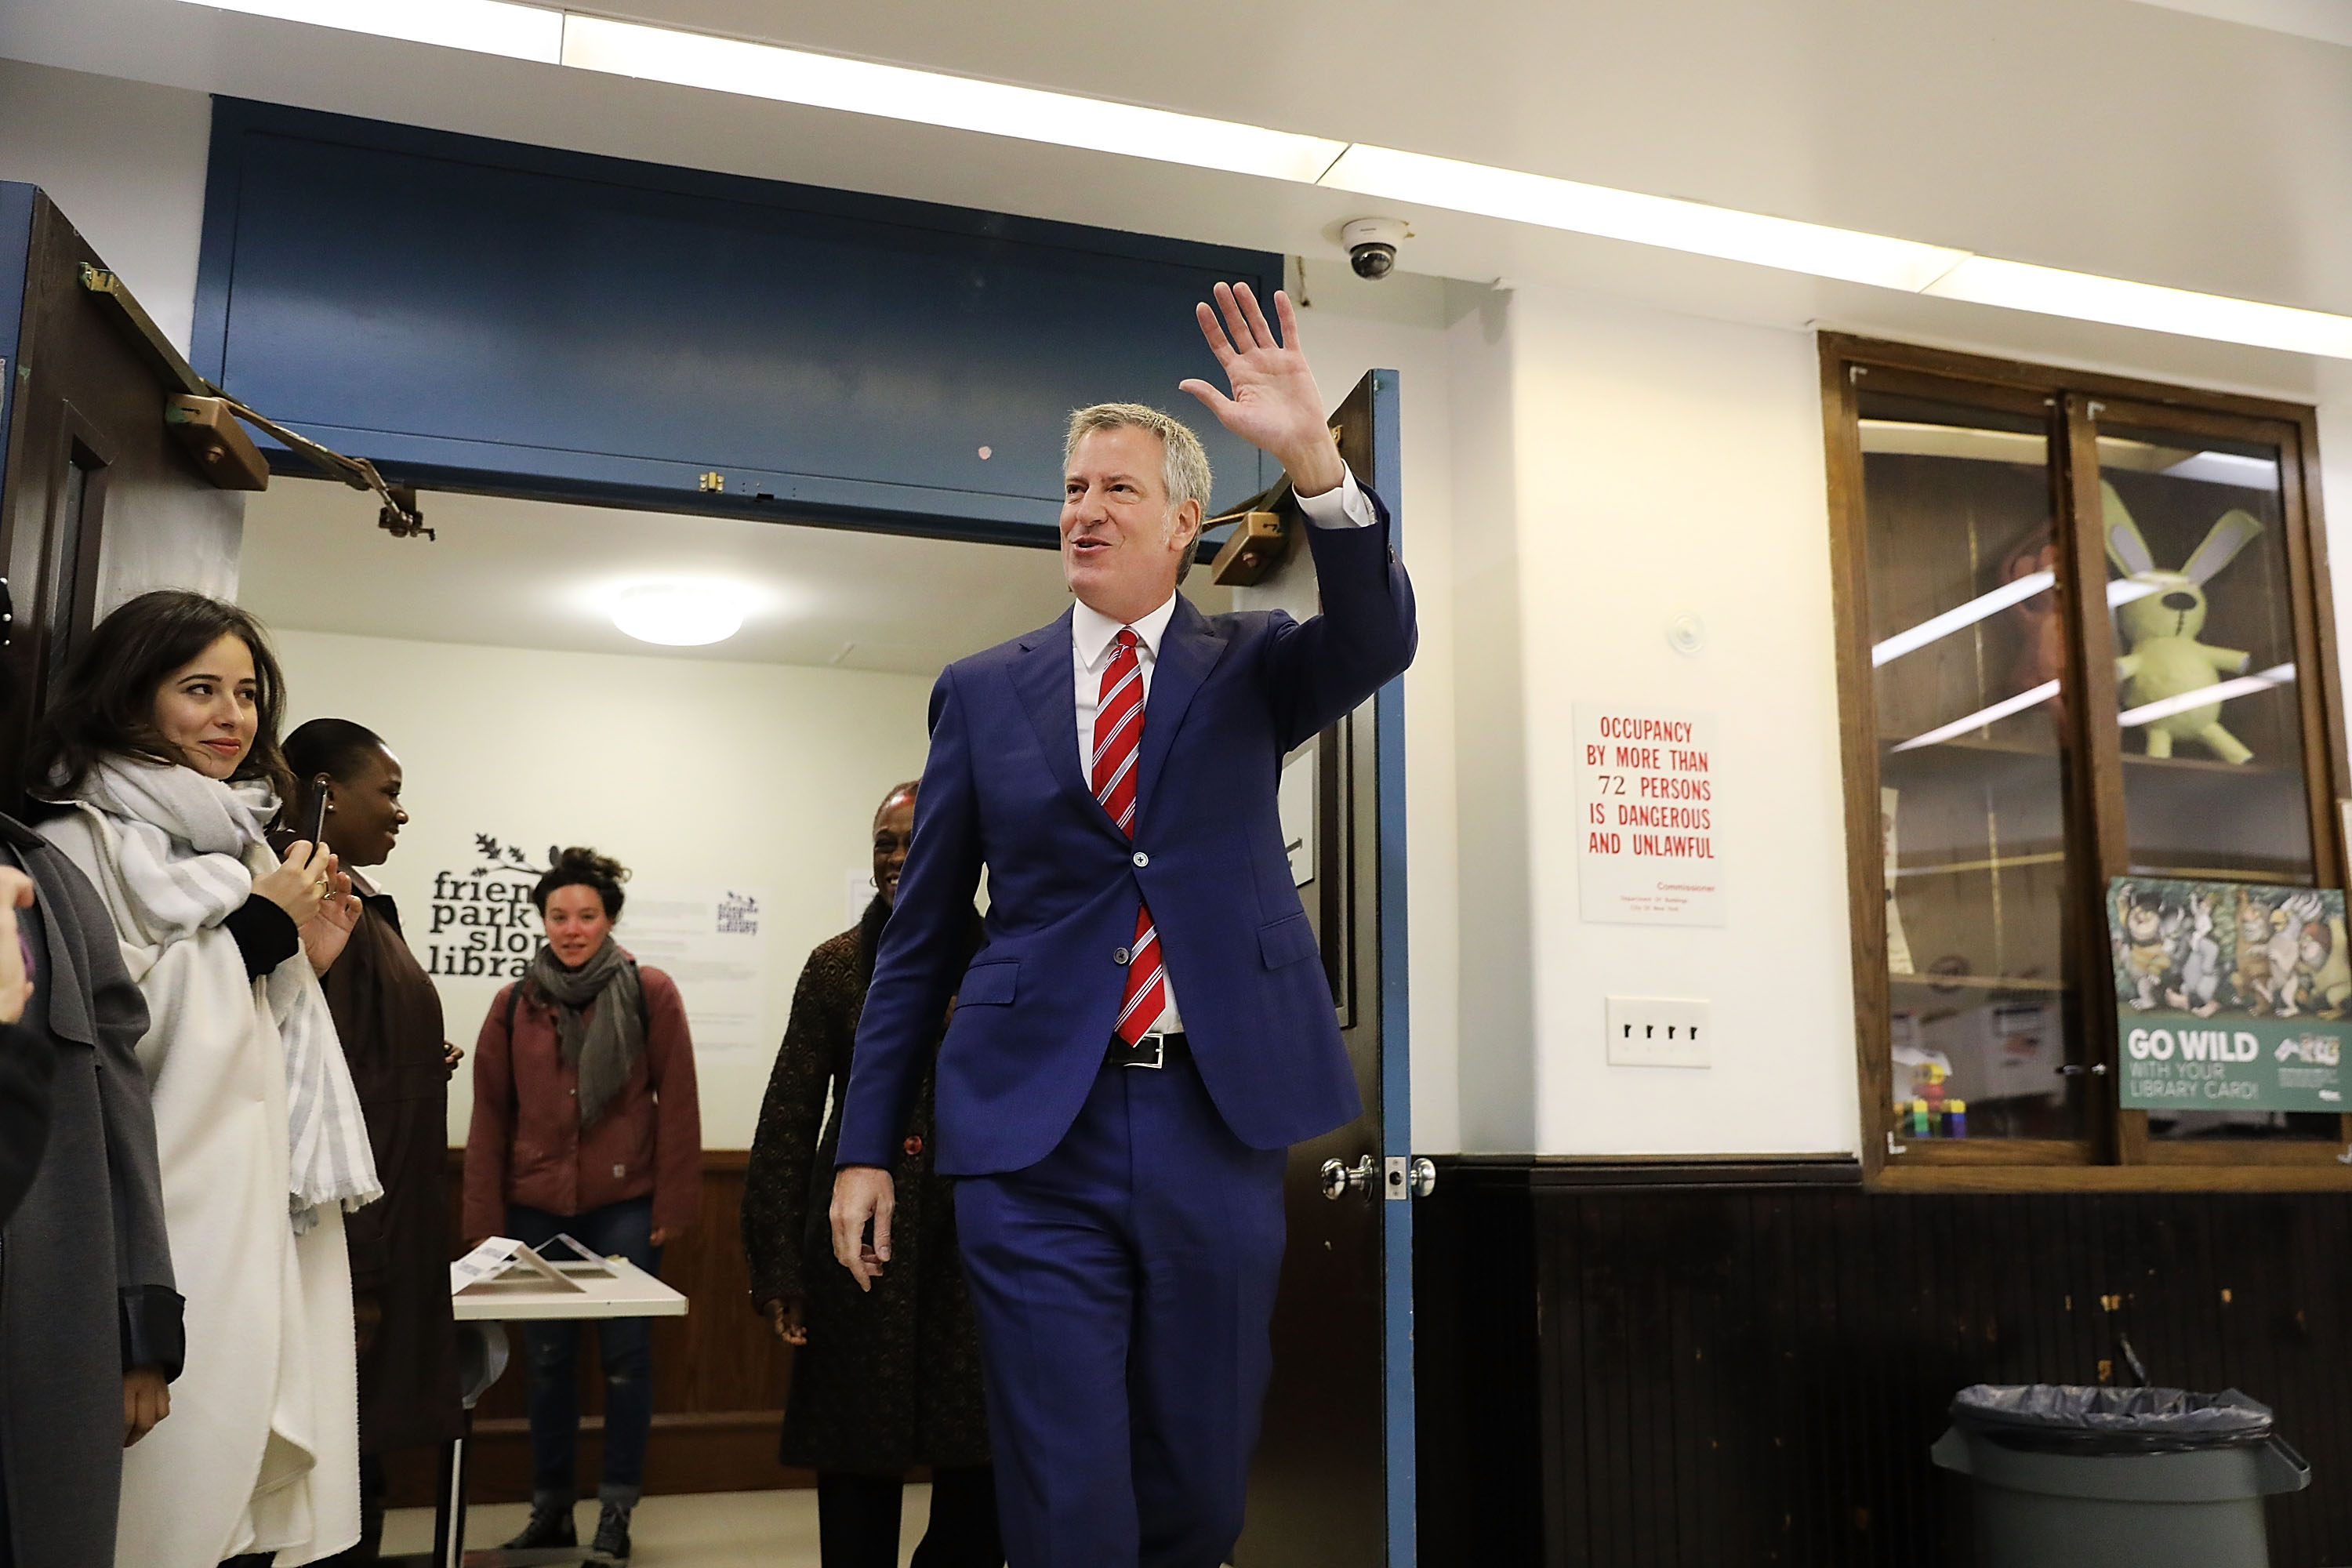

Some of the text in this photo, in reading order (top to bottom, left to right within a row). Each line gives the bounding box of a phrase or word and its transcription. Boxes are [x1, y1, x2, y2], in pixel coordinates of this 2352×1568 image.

[1600, 716, 1692, 743] OCCUPANCY
[1587, 744, 1708, 772] BY MORE THAN
[1599, 775, 1711, 801] 72 PERSONS
[1590, 802, 1711, 829] IS DANGEROUS
[1589, 832, 1715, 858] AND UNLAWFUL
[430, 899, 531, 934] park
[428, 946, 528, 978] libra
[2128, 1028, 2259, 1062] GO WILD
[2129, 1061, 2226, 1080] WITH YOUR
[2129, 1079, 2198, 1098] LIBRARY
